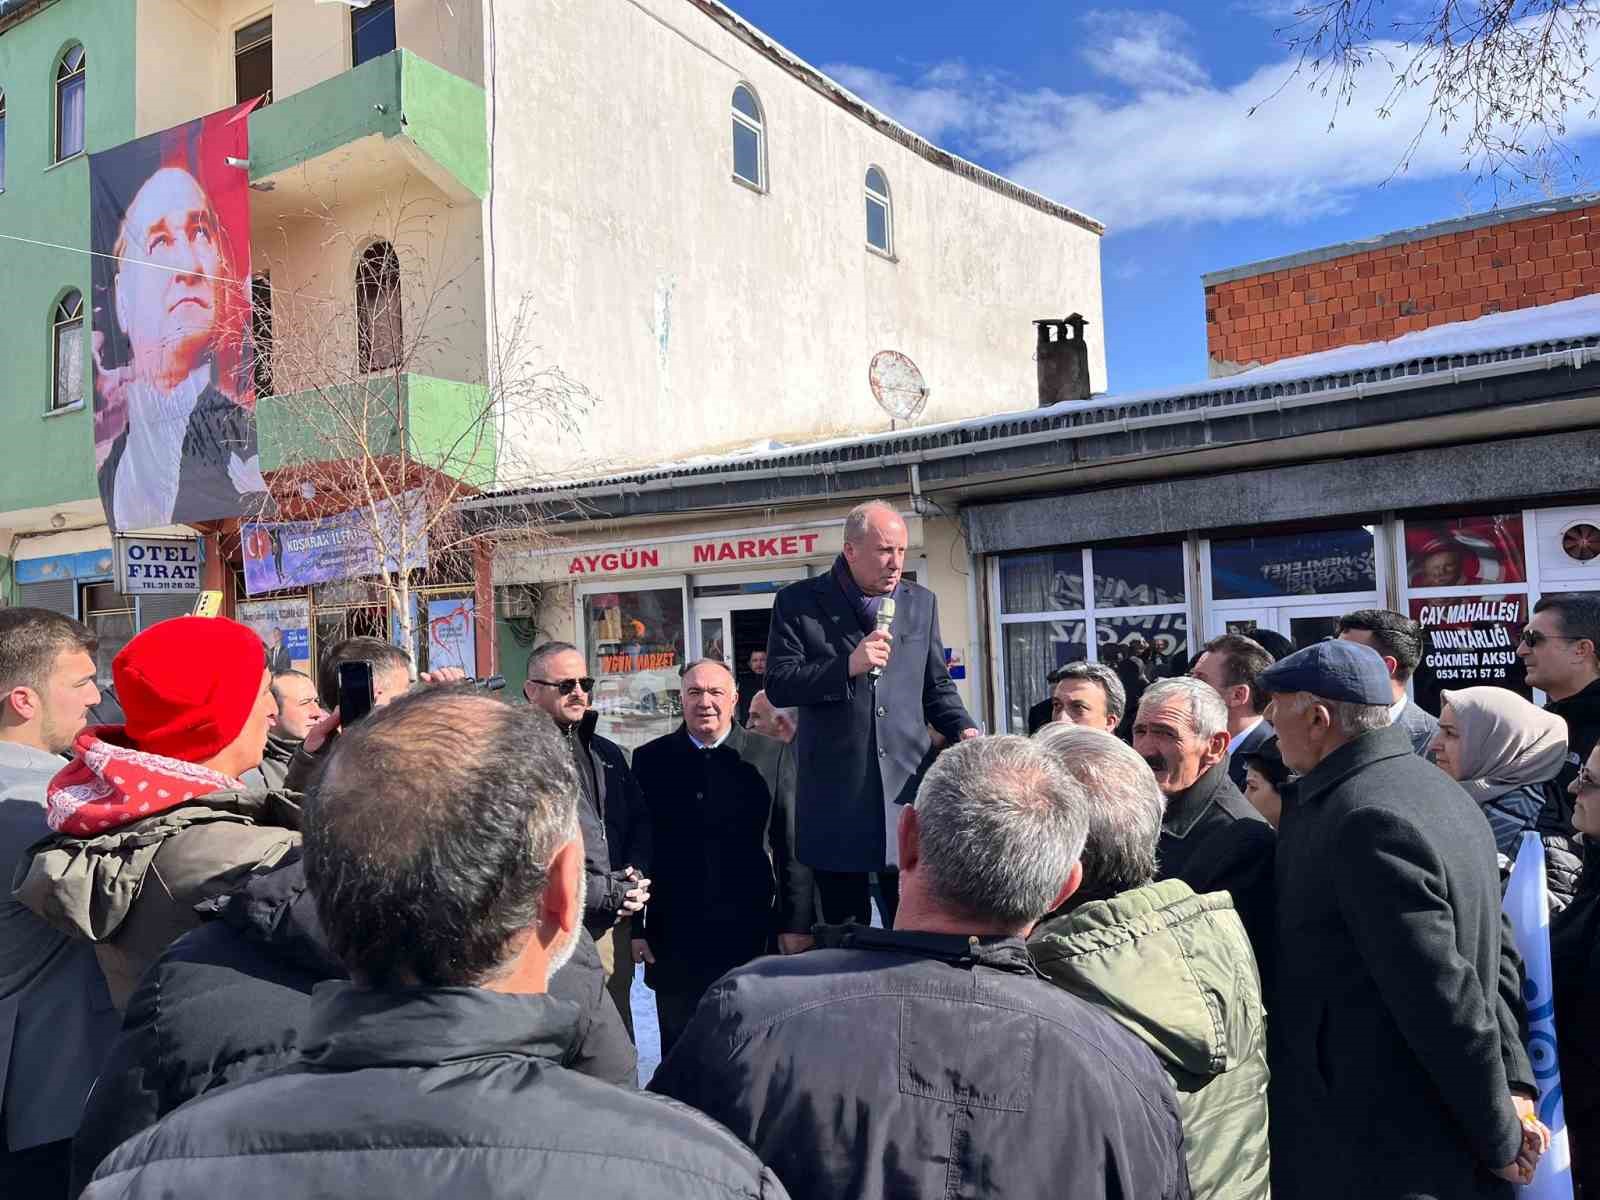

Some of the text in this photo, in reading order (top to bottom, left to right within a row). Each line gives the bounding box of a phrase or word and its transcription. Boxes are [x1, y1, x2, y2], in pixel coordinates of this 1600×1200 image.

[128, 545, 196, 562] OTEL
[569, 533, 819, 574] AYGÜN MARKET
[127, 563, 198, 579] FIRAT
[1419, 601, 1520, 630] ÇAY MAHALLESİ
[1430, 623, 1511, 649] MUHTARLIĞI
[1425, 651, 1516, 668] GÖKMEN AKSU
[1436, 669, 1459, 679] 0534
[1460, 668, 1478, 679] 721
[1480, 668, 1492, 678] 57
